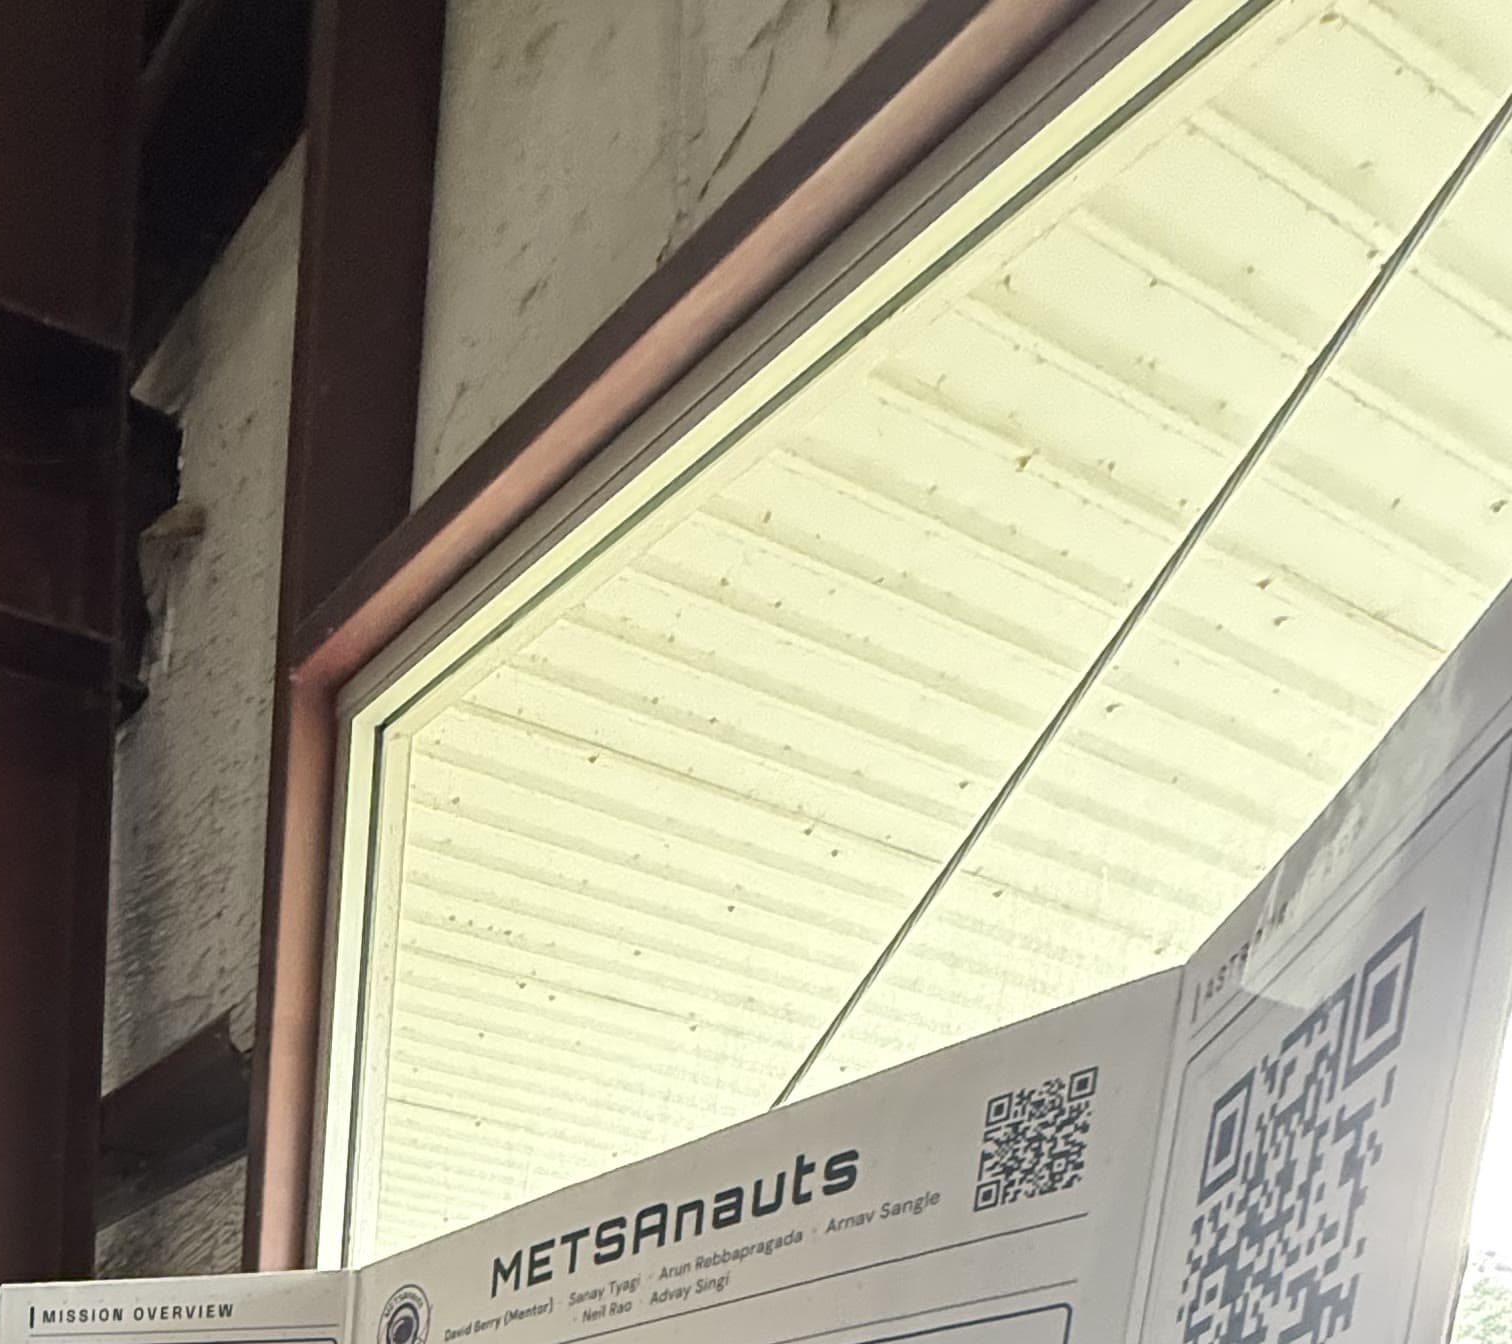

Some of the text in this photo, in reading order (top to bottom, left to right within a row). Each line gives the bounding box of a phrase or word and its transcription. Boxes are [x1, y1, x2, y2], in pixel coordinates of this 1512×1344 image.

[444, 1322, 472, 1343] David
[608, 1273, 641, 1297] Tyagi
[658, 1262, 691, 1281] Arun
[695, 1229, 803, 1271] Rebbapragada
[824, 1210, 876, 1234] Arnav
[879, 1191, 941, 1220] Sangle
[491, 1149, 860, 1299] METSAnauts
[42, 1304, 233, 1323] MISSION OVERVIEW
[582, 1271, 730, 1323] Neil Rao Advay Singi
